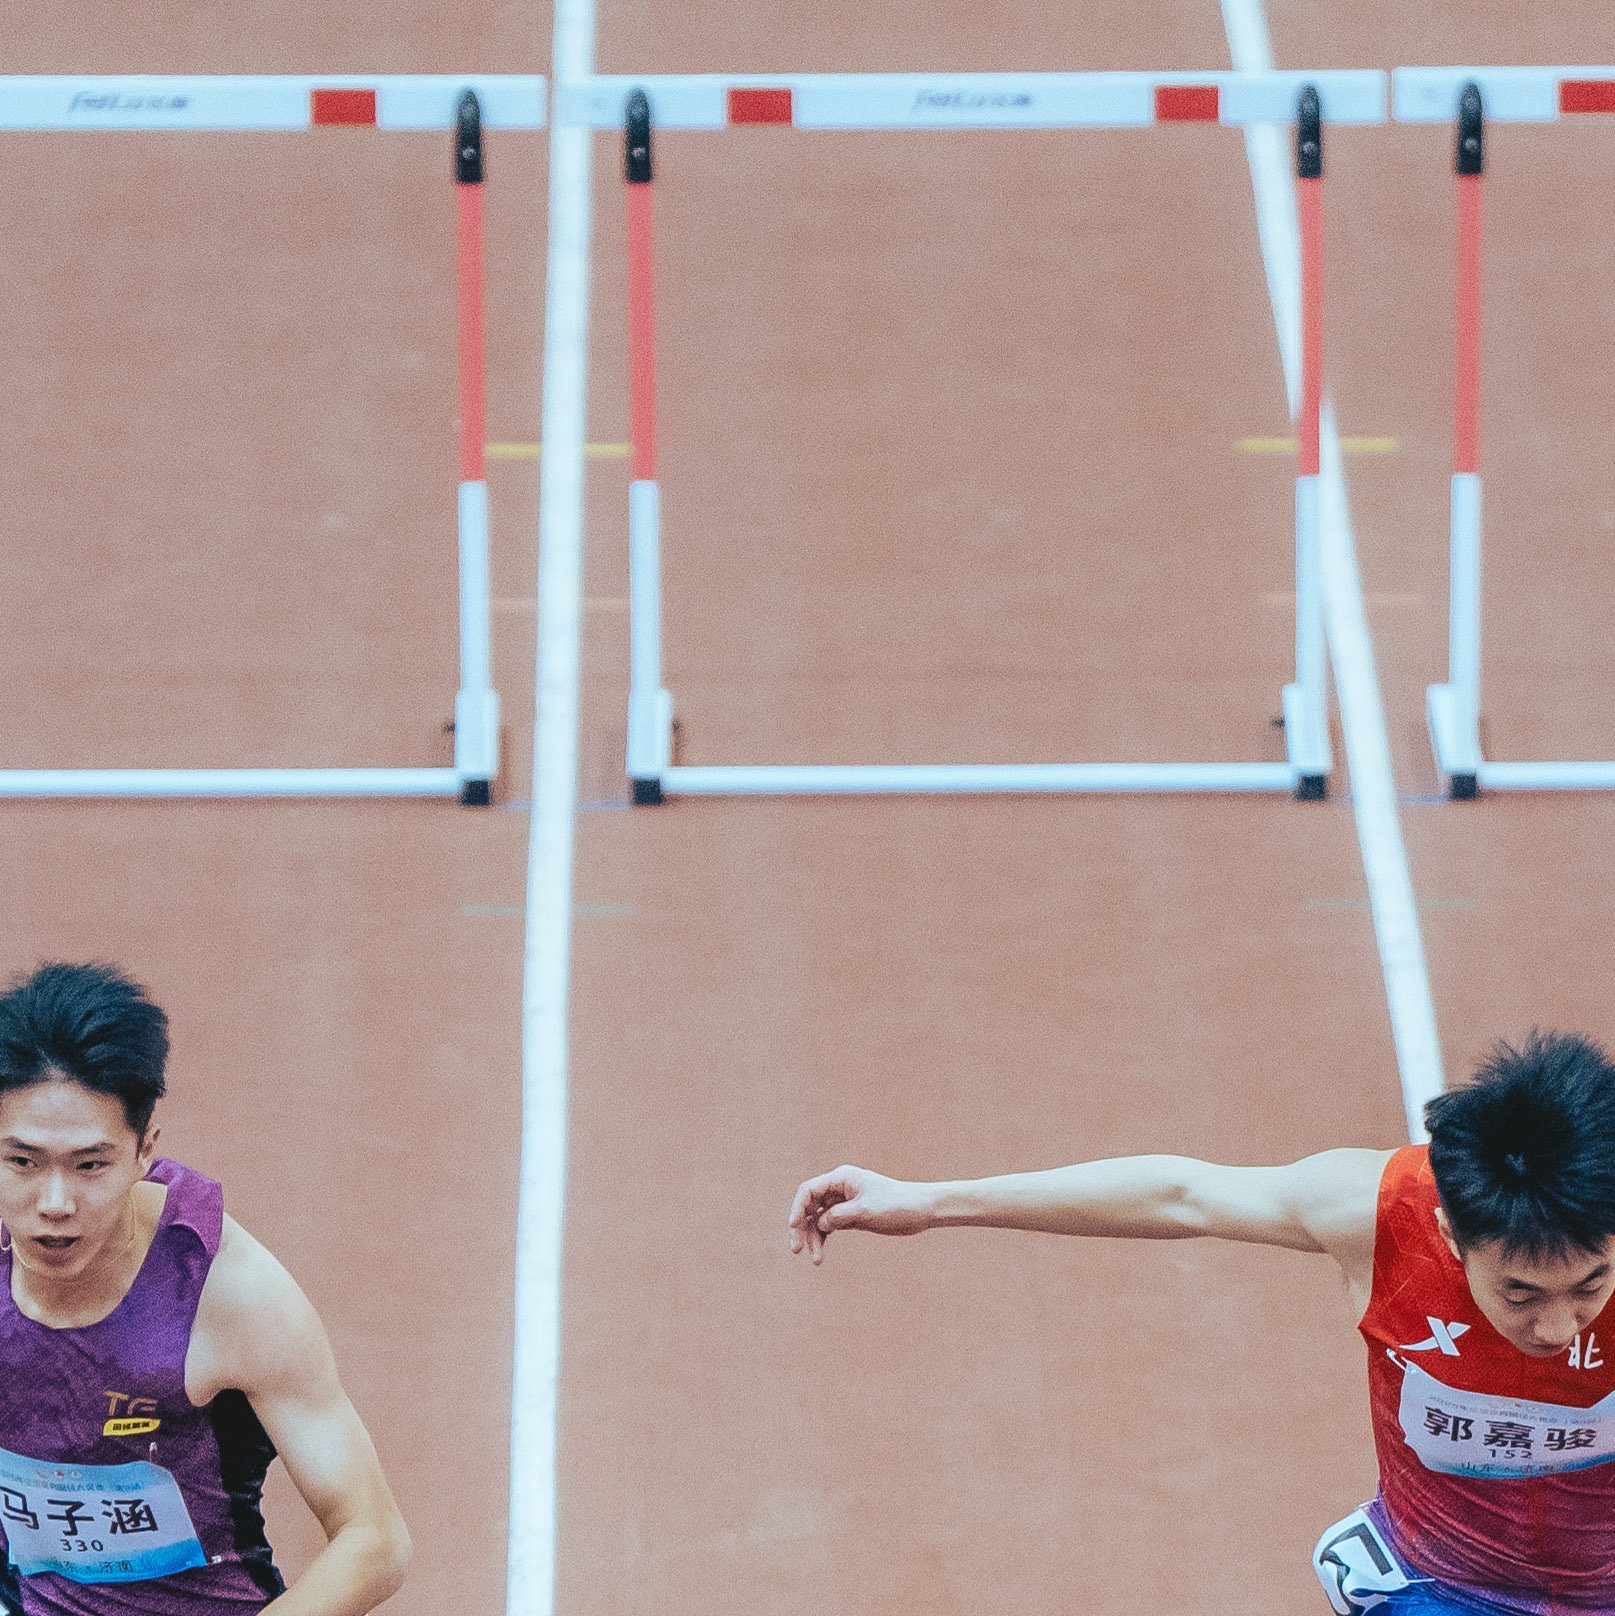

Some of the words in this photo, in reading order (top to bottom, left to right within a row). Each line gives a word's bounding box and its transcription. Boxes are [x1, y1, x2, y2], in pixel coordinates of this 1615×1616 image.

[1423, 1404, 1597, 1451] 郭嘉骏
[1489, 1449, 1532, 1459] 152
[0, 1485, 158, 1537] 马子涵
[60, 1539, 103, 1552] 330
